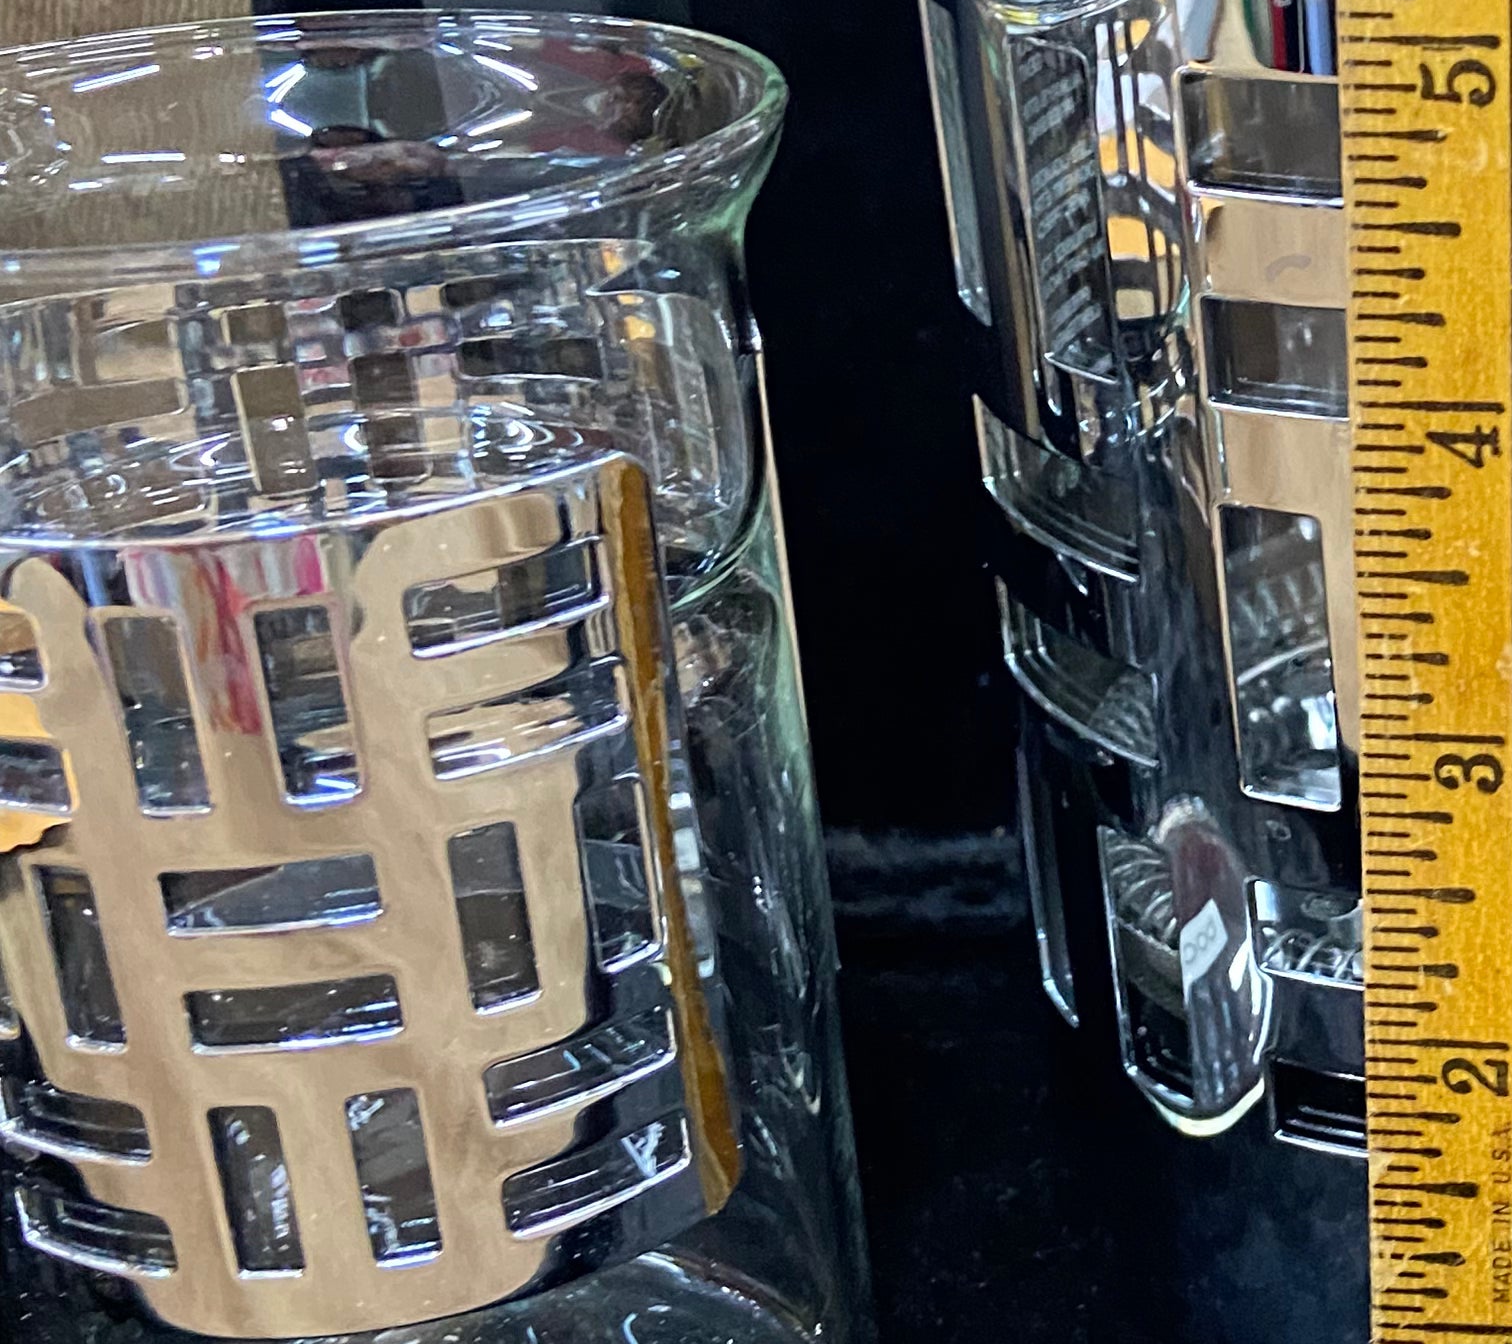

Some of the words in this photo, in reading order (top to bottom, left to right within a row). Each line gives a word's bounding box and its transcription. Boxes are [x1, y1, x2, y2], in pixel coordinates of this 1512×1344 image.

[1419, 57, 1497, 109] 5
[1426, 424, 1503, 469] 4
[1433, 752, 1505, 796] 3
[1441, 1057, 1511, 1097] 2
[1492, 1200, 1512, 1224] IN
[1492, 1240, 1512, 1304] MADE
